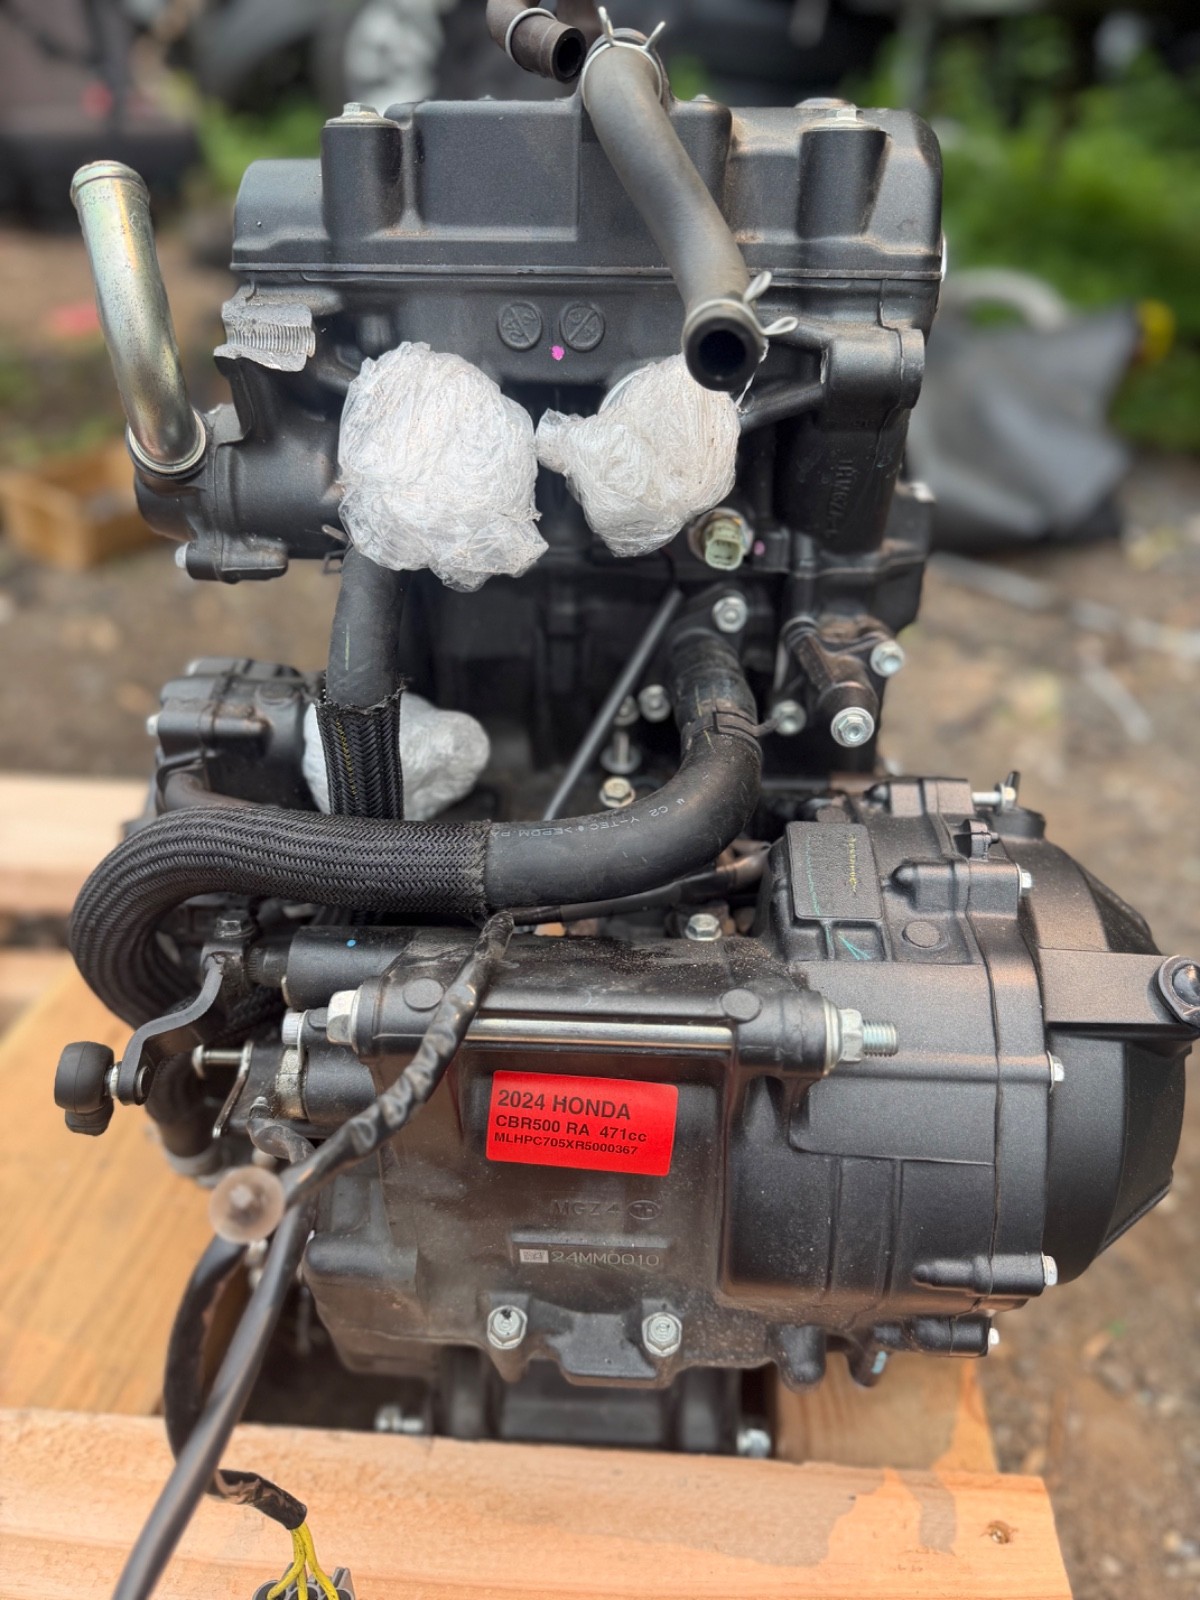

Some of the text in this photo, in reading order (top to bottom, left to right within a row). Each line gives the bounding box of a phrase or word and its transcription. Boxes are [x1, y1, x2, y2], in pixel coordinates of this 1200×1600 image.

[497, 1089, 631, 1120] 2024 HONDA
[495, 1114, 647, 1142] CBR500 RA 471cc
[494, 1132, 638, 1155] MLHPC705XR5000367
